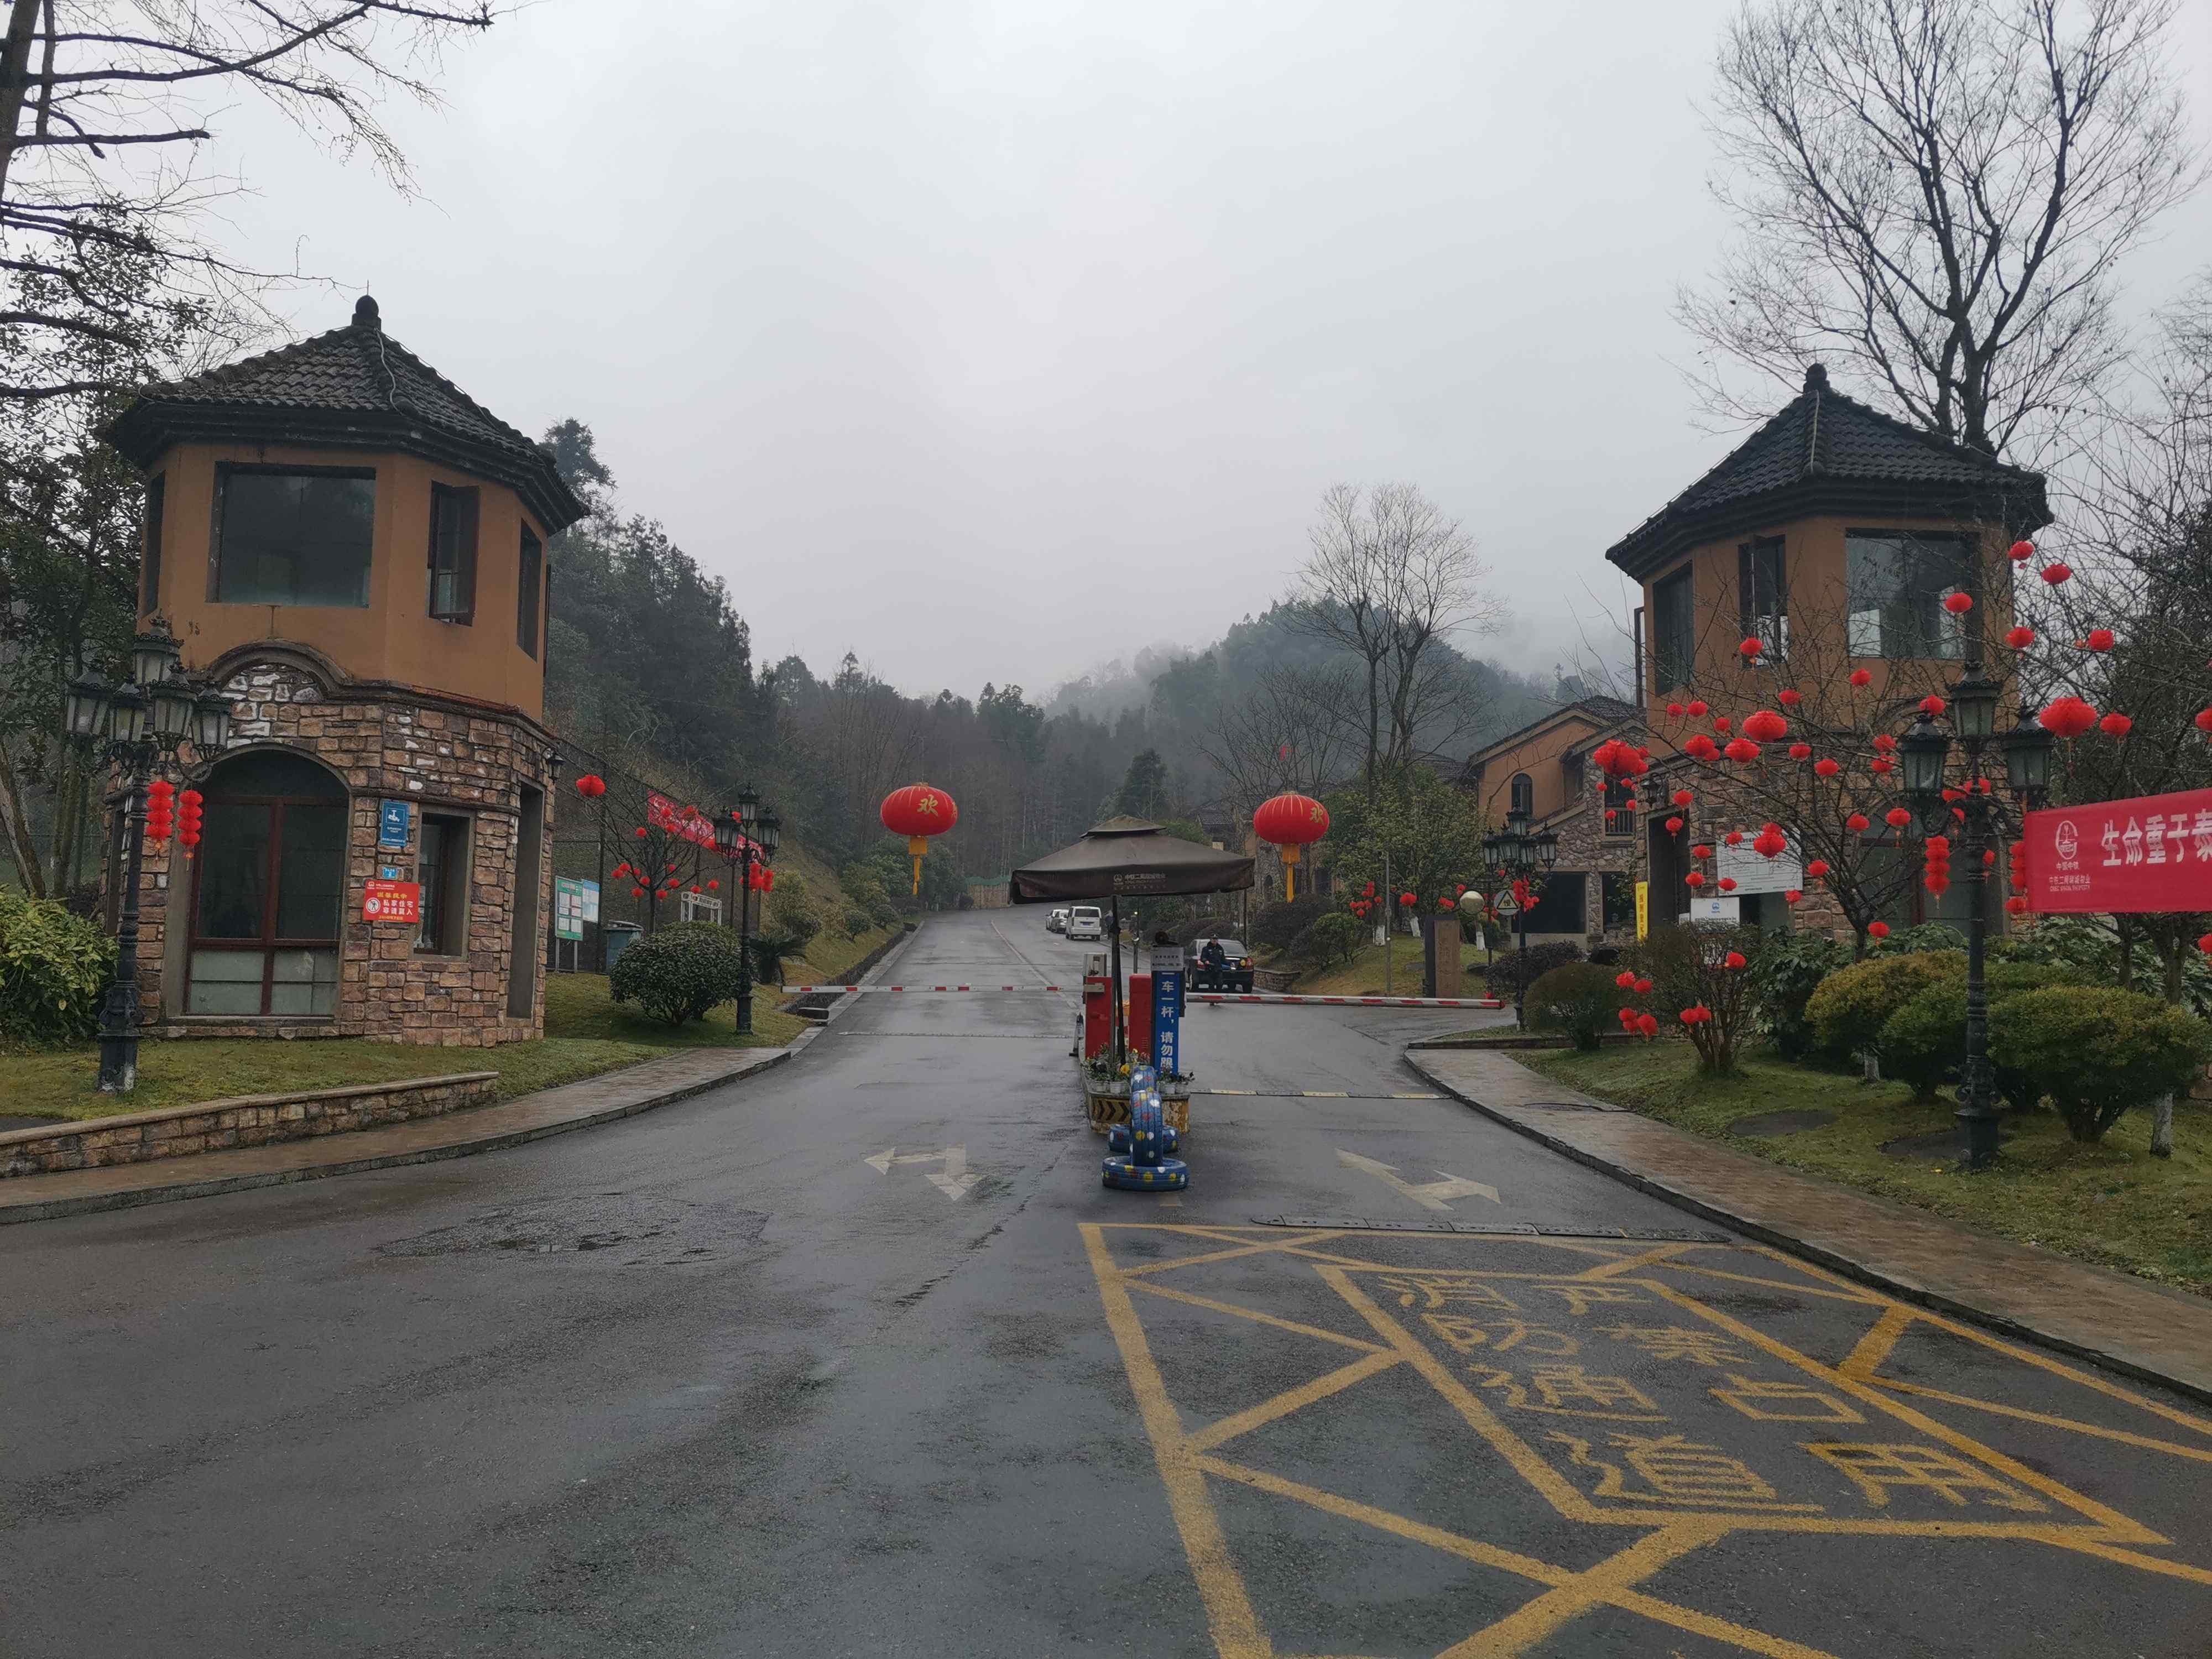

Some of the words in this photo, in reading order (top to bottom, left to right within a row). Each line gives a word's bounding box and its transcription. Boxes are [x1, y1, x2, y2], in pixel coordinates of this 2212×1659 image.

[1378, 1275, 1825, 1513] 消防通道
[1530, 1284, 2051, 1514] 严禁占用
